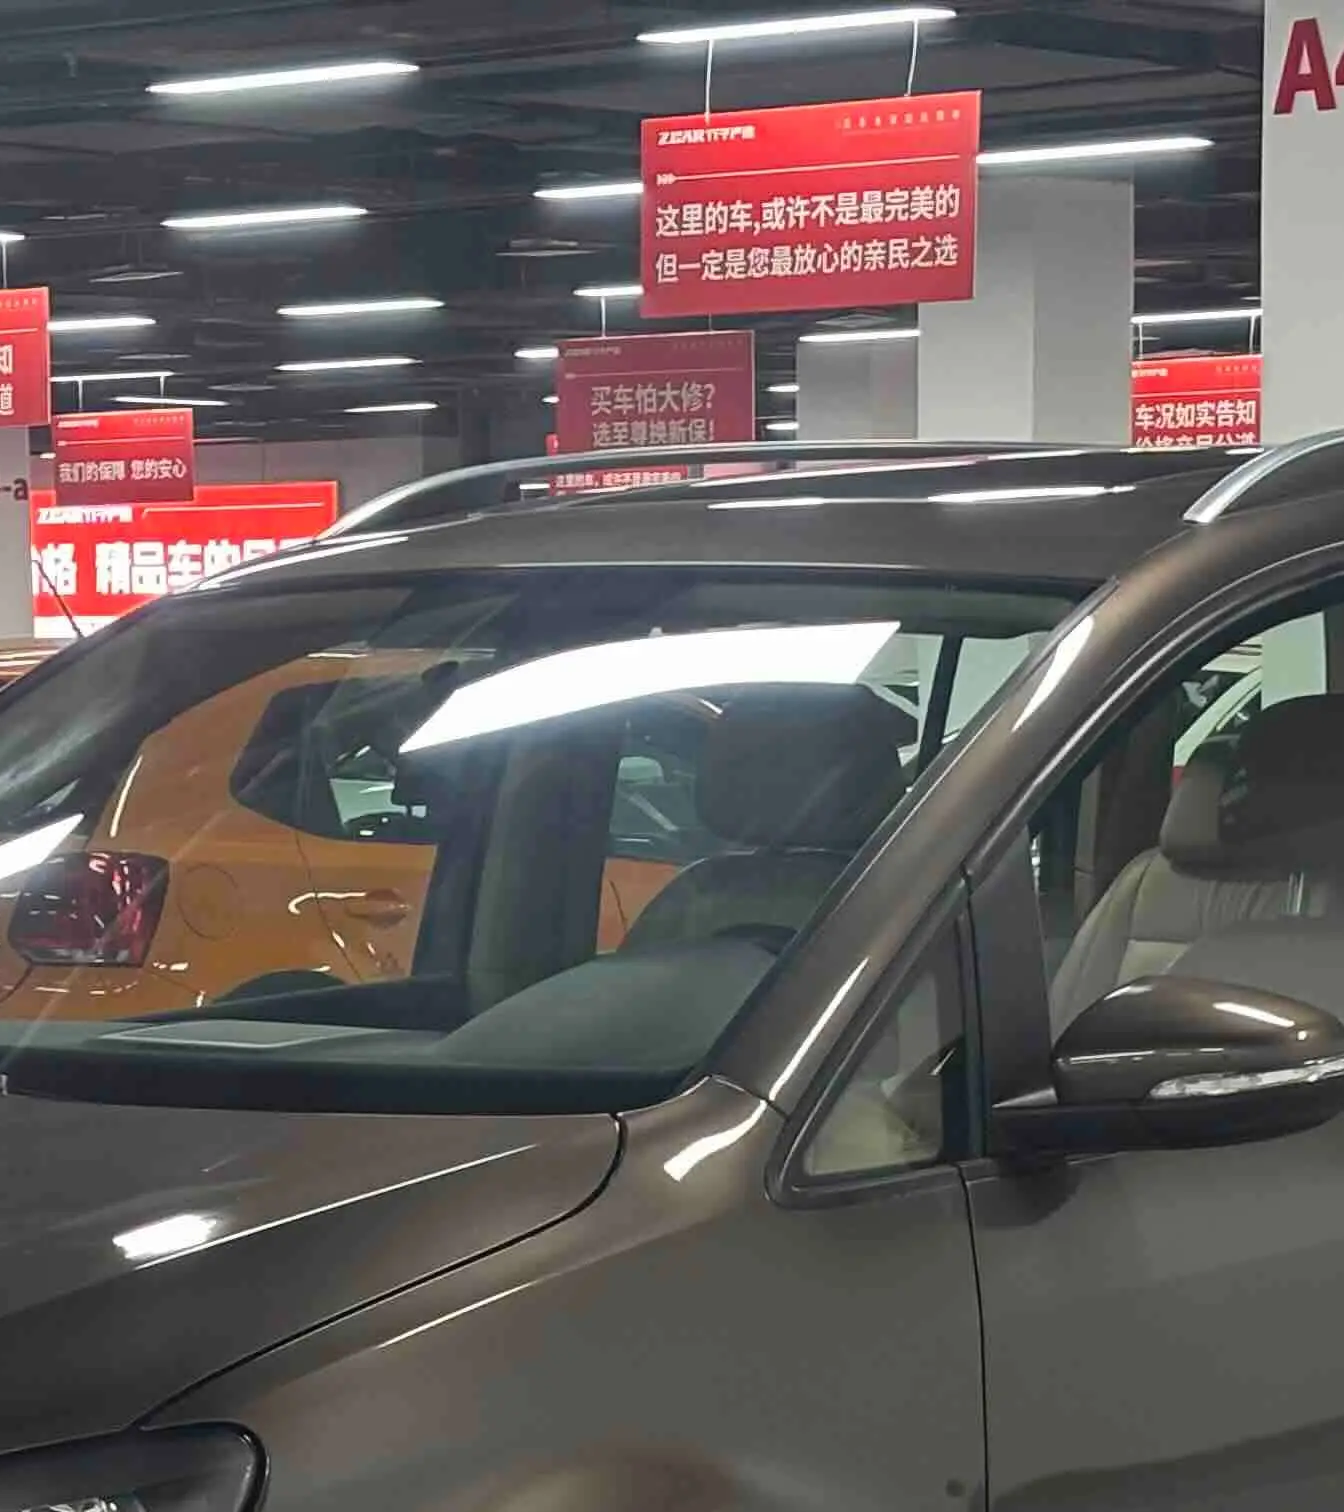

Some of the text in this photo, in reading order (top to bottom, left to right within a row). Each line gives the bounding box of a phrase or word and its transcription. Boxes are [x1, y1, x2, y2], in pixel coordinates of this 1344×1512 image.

[656, 184, 961, 237] 这里的车,或许不是最完美的
[656, 235, 958, 284] 但一定是您最放心的亲民之选
[591, 382, 716, 416] 买车怕大修?
[1135, 399, 1257, 431] 车况如实告知
[592, 418, 714, 447] 选至尊换新保!
[58, 457, 188, 484] 我们的保障 您的安心
